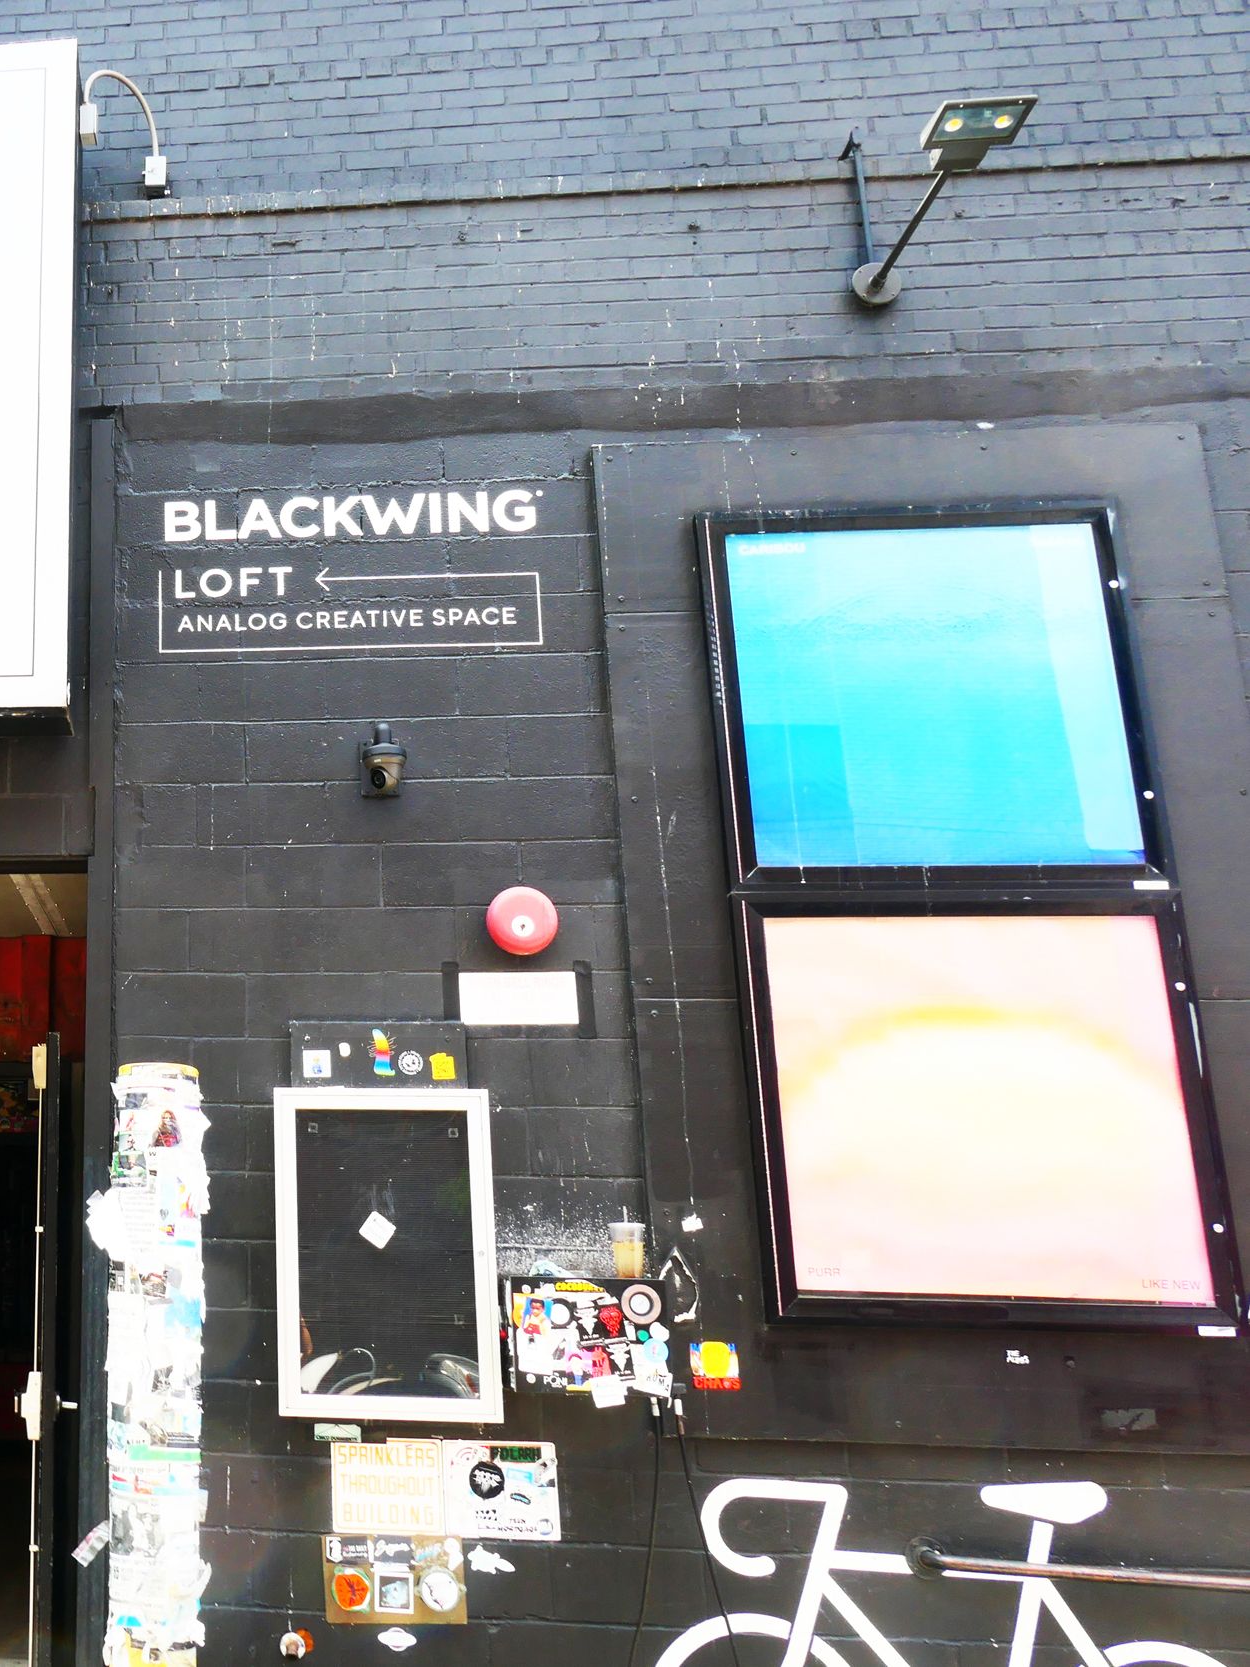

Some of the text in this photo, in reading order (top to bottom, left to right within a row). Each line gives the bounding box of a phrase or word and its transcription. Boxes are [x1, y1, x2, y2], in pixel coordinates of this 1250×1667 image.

[174, 566, 293, 599] LOFT
[178, 607, 518, 633] ANALOG CREATIVE SPACE
[807, 1267, 841, 1278] PURR
[1141, 1278, 1201, 1290] LIKE NEW
[337, 1445, 436, 1468] SPRINKLERS
[340, 1472, 434, 1497] THROUGHOUT
[342, 1502, 434, 1526] BUILDING
